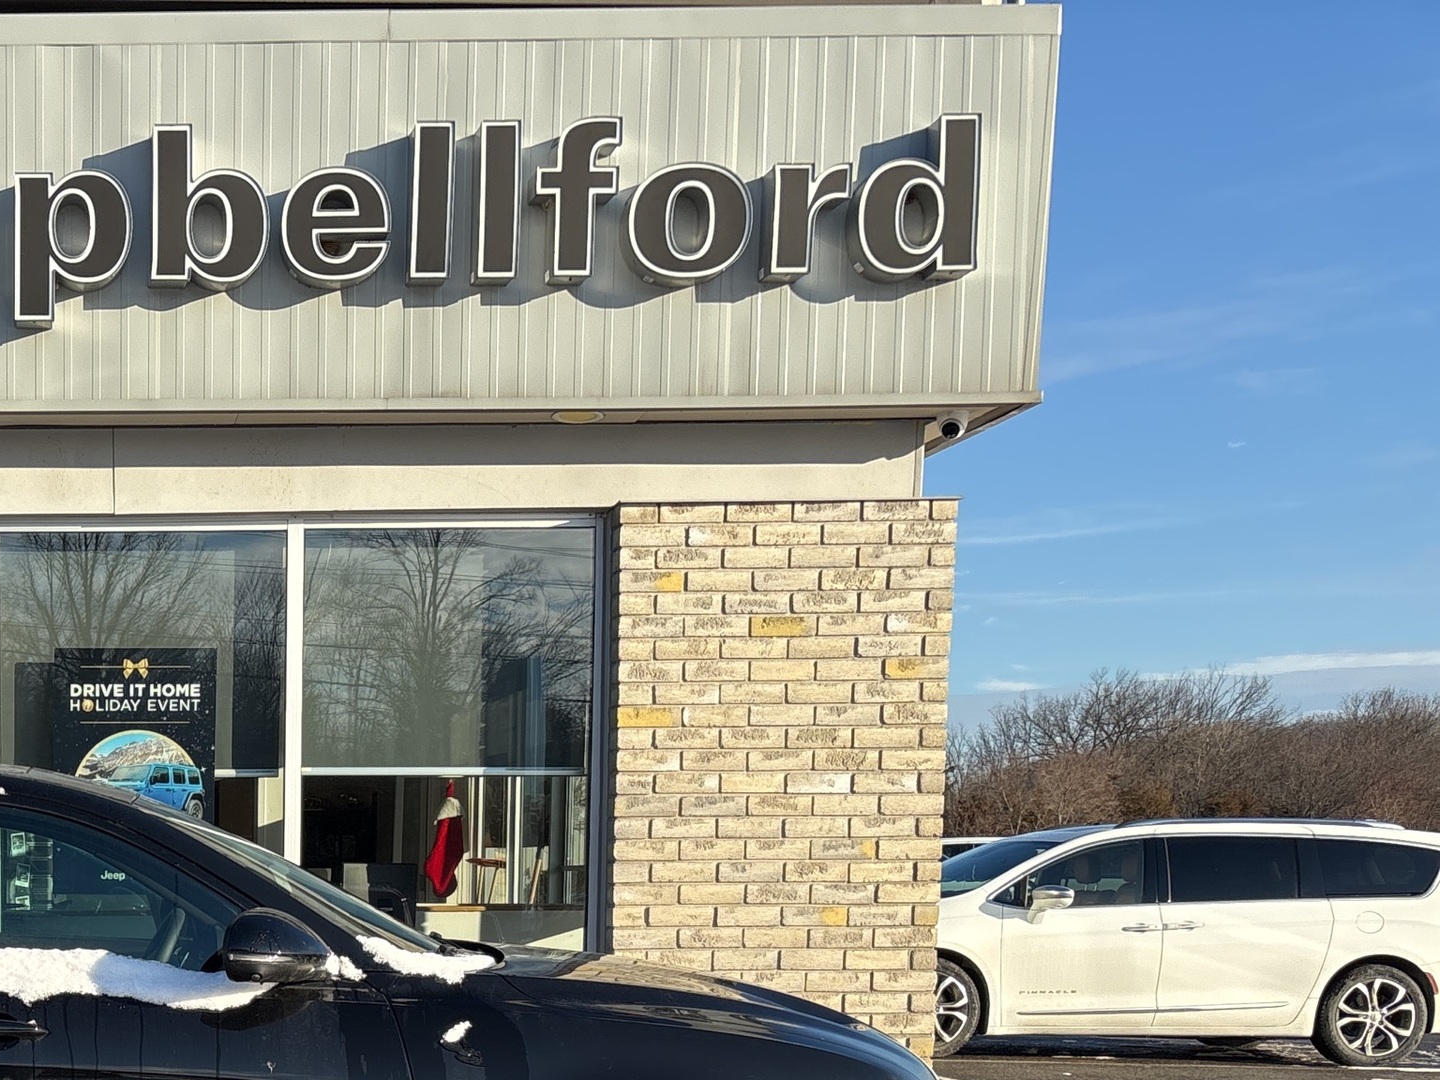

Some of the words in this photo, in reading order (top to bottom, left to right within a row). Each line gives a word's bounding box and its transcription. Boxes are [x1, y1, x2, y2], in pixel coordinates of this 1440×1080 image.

[70, 683, 124, 697] DRIVE
[129, 683, 146, 697] IT
[149, 683, 201, 697] HOME
[70, 699, 141, 712] HOLIDAY
[147, 699, 201, 712] EVENT
[100, 869, 126, 882] Jeep
